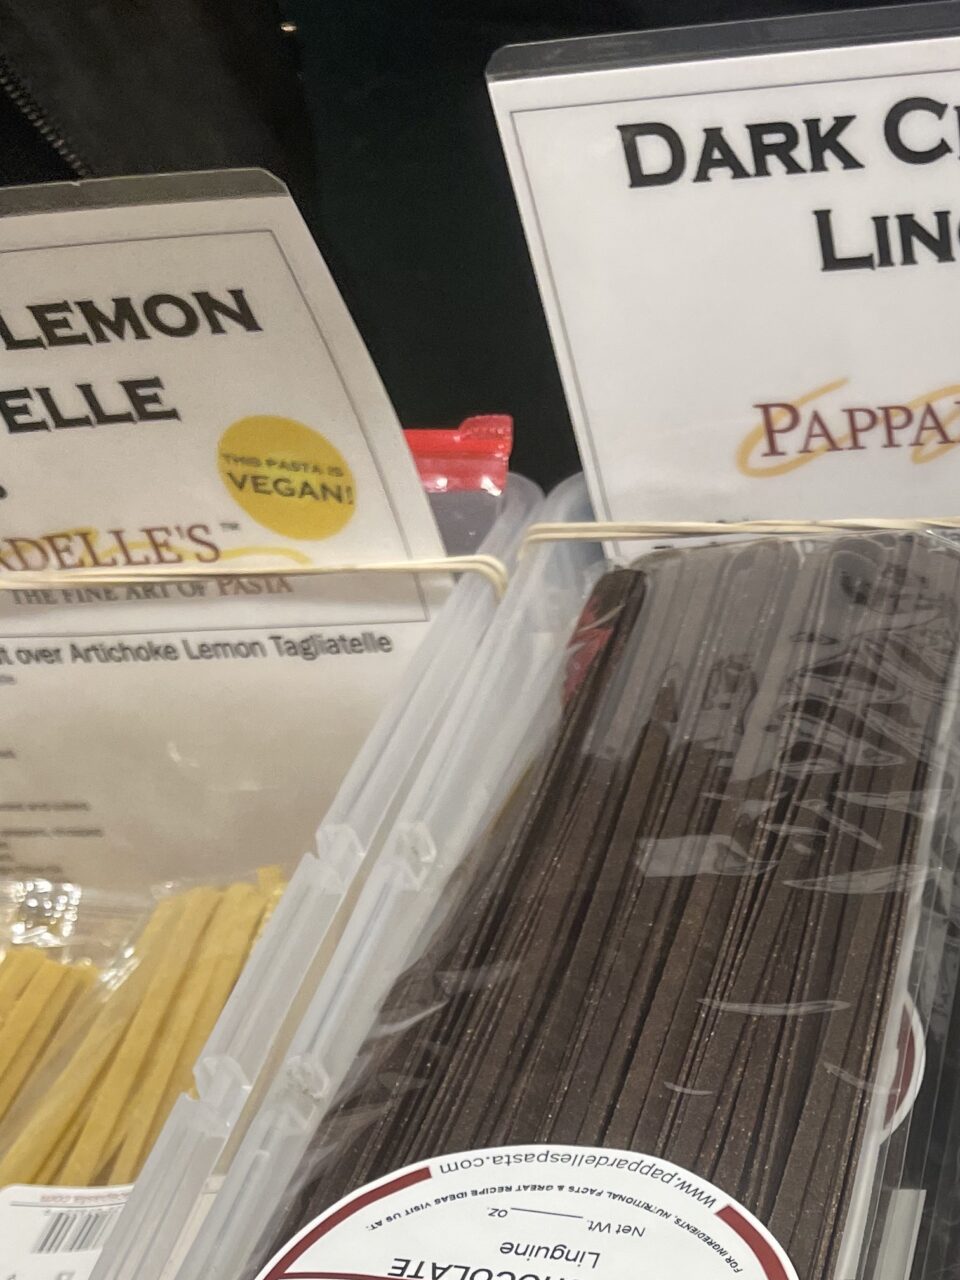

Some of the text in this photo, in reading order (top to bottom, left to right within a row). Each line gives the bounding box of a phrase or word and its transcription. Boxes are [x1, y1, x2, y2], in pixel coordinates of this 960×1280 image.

[616, 114, 866, 189] DARK
[0, 289, 263, 350] LEMON
[0, 376, 181, 434] ELLE
[265, 457, 323, 475] PASTA
[227, 471, 354, 505] VEGAN!
[216, 576, 294, 597] PASTA
[16, 649, 62, 666] over
[70, 642, 179, 665] Artichoke
[184, 639, 266, 661] Lemon
[269, 632, 393, 660] Tagliatelle
[439, 1149, 717, 1209] www.pappardellespasta.com
[515, 1184, 554, 1193] GREAT
[434, 1191, 468, 1205] IDEAS
[471, 1185, 513, 1198] RECIPE
[568, 1185, 604, 1197] FACTS
[385, 1212, 402, 1223] US
[404, 1202, 432, 1217] VISIT
[616, 1224, 646, 1238] Net
[499, 1241, 601, 1269] Linguine
[724, 1254, 744, 1274] FOR
